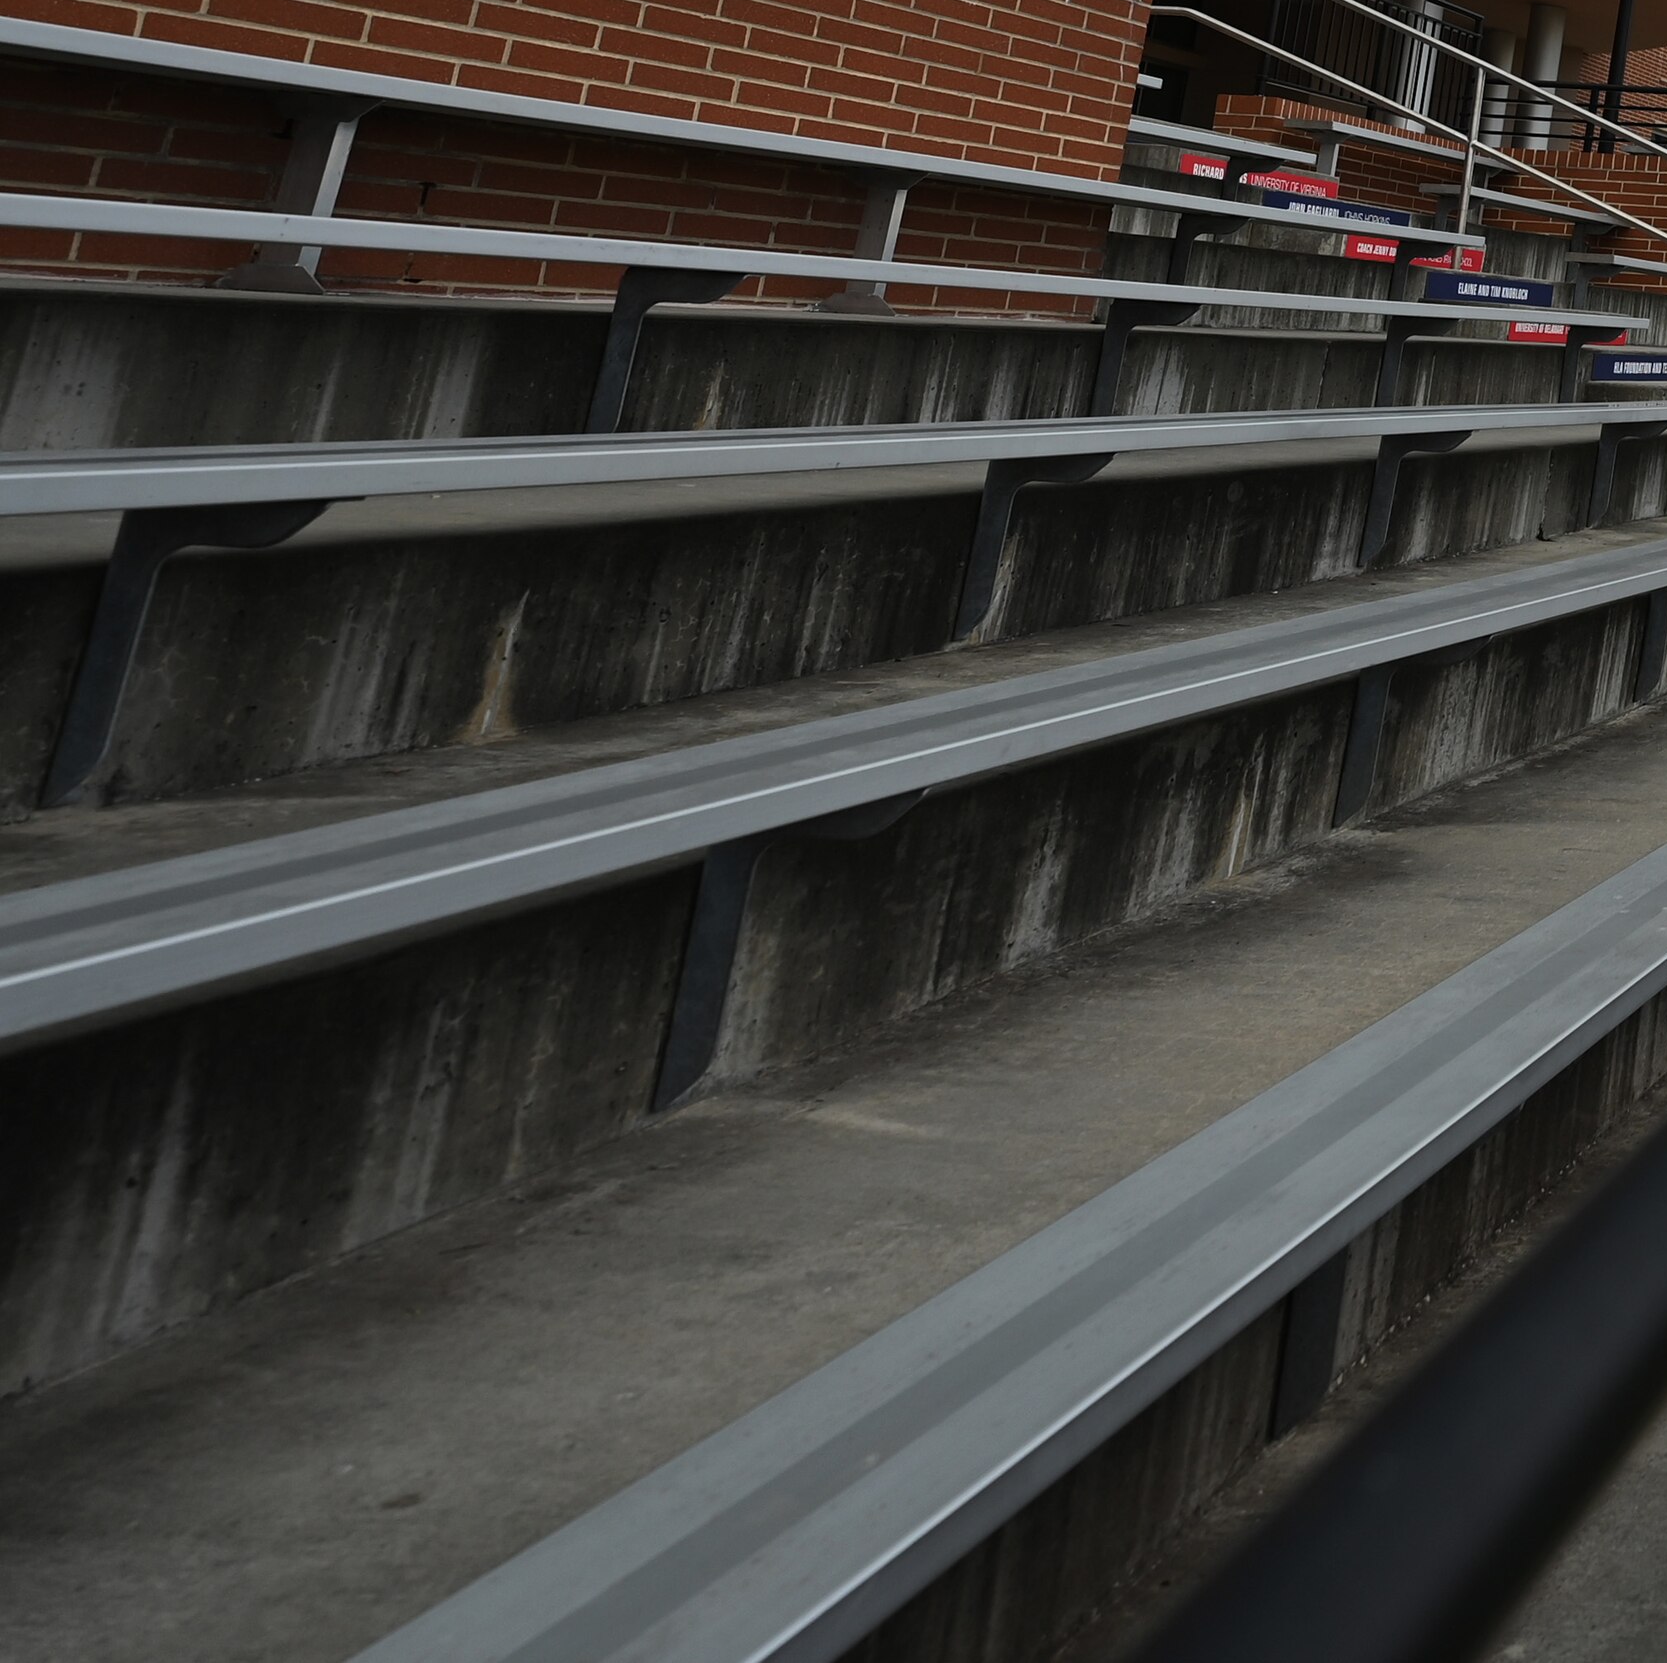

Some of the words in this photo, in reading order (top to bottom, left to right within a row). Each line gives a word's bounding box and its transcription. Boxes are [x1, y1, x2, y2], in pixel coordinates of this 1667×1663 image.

[1193, 163, 1225, 180] RICHARD
[1251, 174, 1289, 191] UNIVERSITY
[1289, 182, 1300, 192] OF
[1300, 183, 1327, 198] VIRGINIA
[1357, 243, 1374, 255] COACH
[1457, 282, 1478, 296] ELAINE
[1477, 284, 1490, 297] AND
[1490, 285, 1501, 298] TIM
[1501, 286, 1529, 301] KNOBLOCH
[1652, 362, 1663, 375] AND
